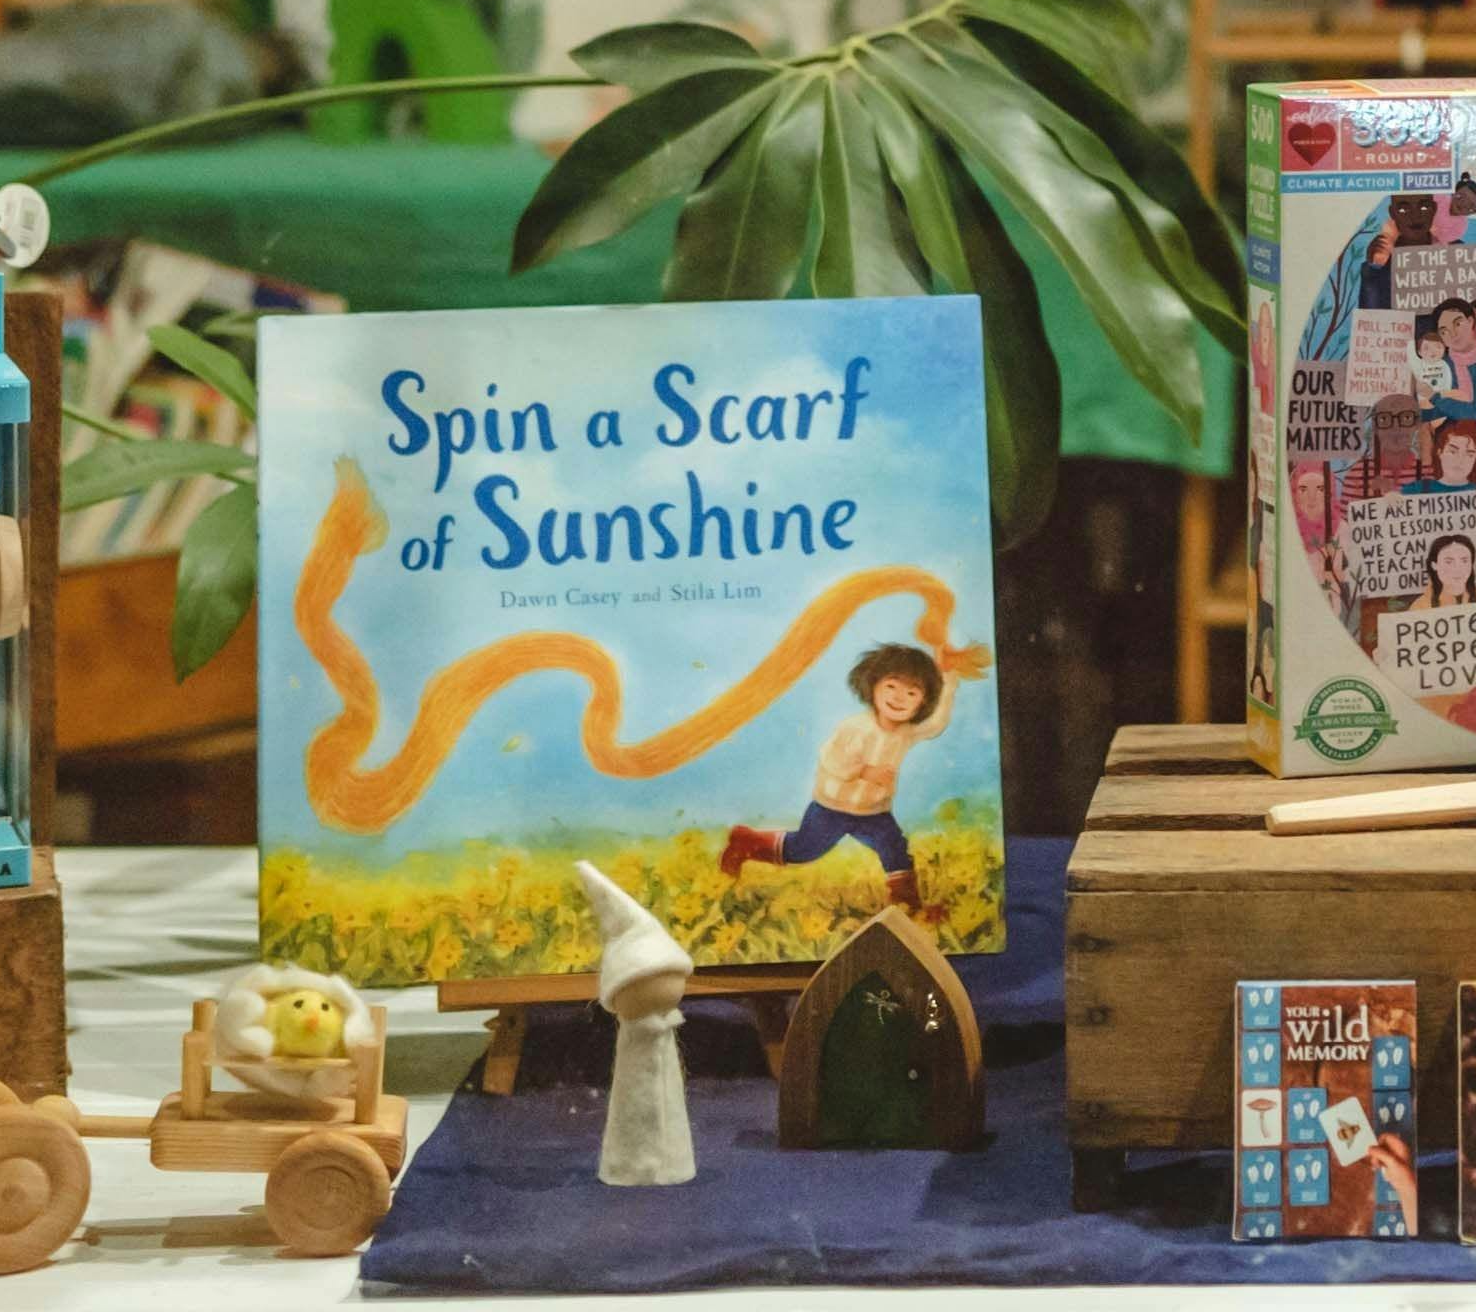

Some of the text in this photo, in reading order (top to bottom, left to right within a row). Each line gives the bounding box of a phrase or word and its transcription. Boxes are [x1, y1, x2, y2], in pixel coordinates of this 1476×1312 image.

[1251, 104, 1274, 145] 500
[1365, 152, 1430, 165] ROUND
[1287, 173, 1449, 189] CLIMATE ACTION PUZZLE
[1396, 251, 1411, 268] IF
[1418, 248, 1447, 267] THE
[1396, 270, 1437, 289] WERE
[1443, 269, 1454, 284] A
[1292, 369, 1335, 396] OUR
[381, 355, 872, 494] Spin a Scarf
[1288, 400, 1358, 425] FUTURE
[1286, 426, 1362, 452] MATTERS
[401, 470, 858, 572] of Sunshine
[1351, 502, 1377, 522] WE
[1384, 498, 1414, 520] ARE
[1352, 514, 1476, 544] OUR LESSONS SO
[1361, 538, 1427, 559] WE CAN
[1365, 556, 1426, 576] TEACH
[1357, 571, 1429, 593] YOU ONE
[499, 582, 762, 609] Dawn Casey and Stila Lim
[1286, 1005, 1320, 1019] YOUR
[1286, 1004, 1371, 1043] wild
[1286, 1043, 1370, 1063] MEMORY
